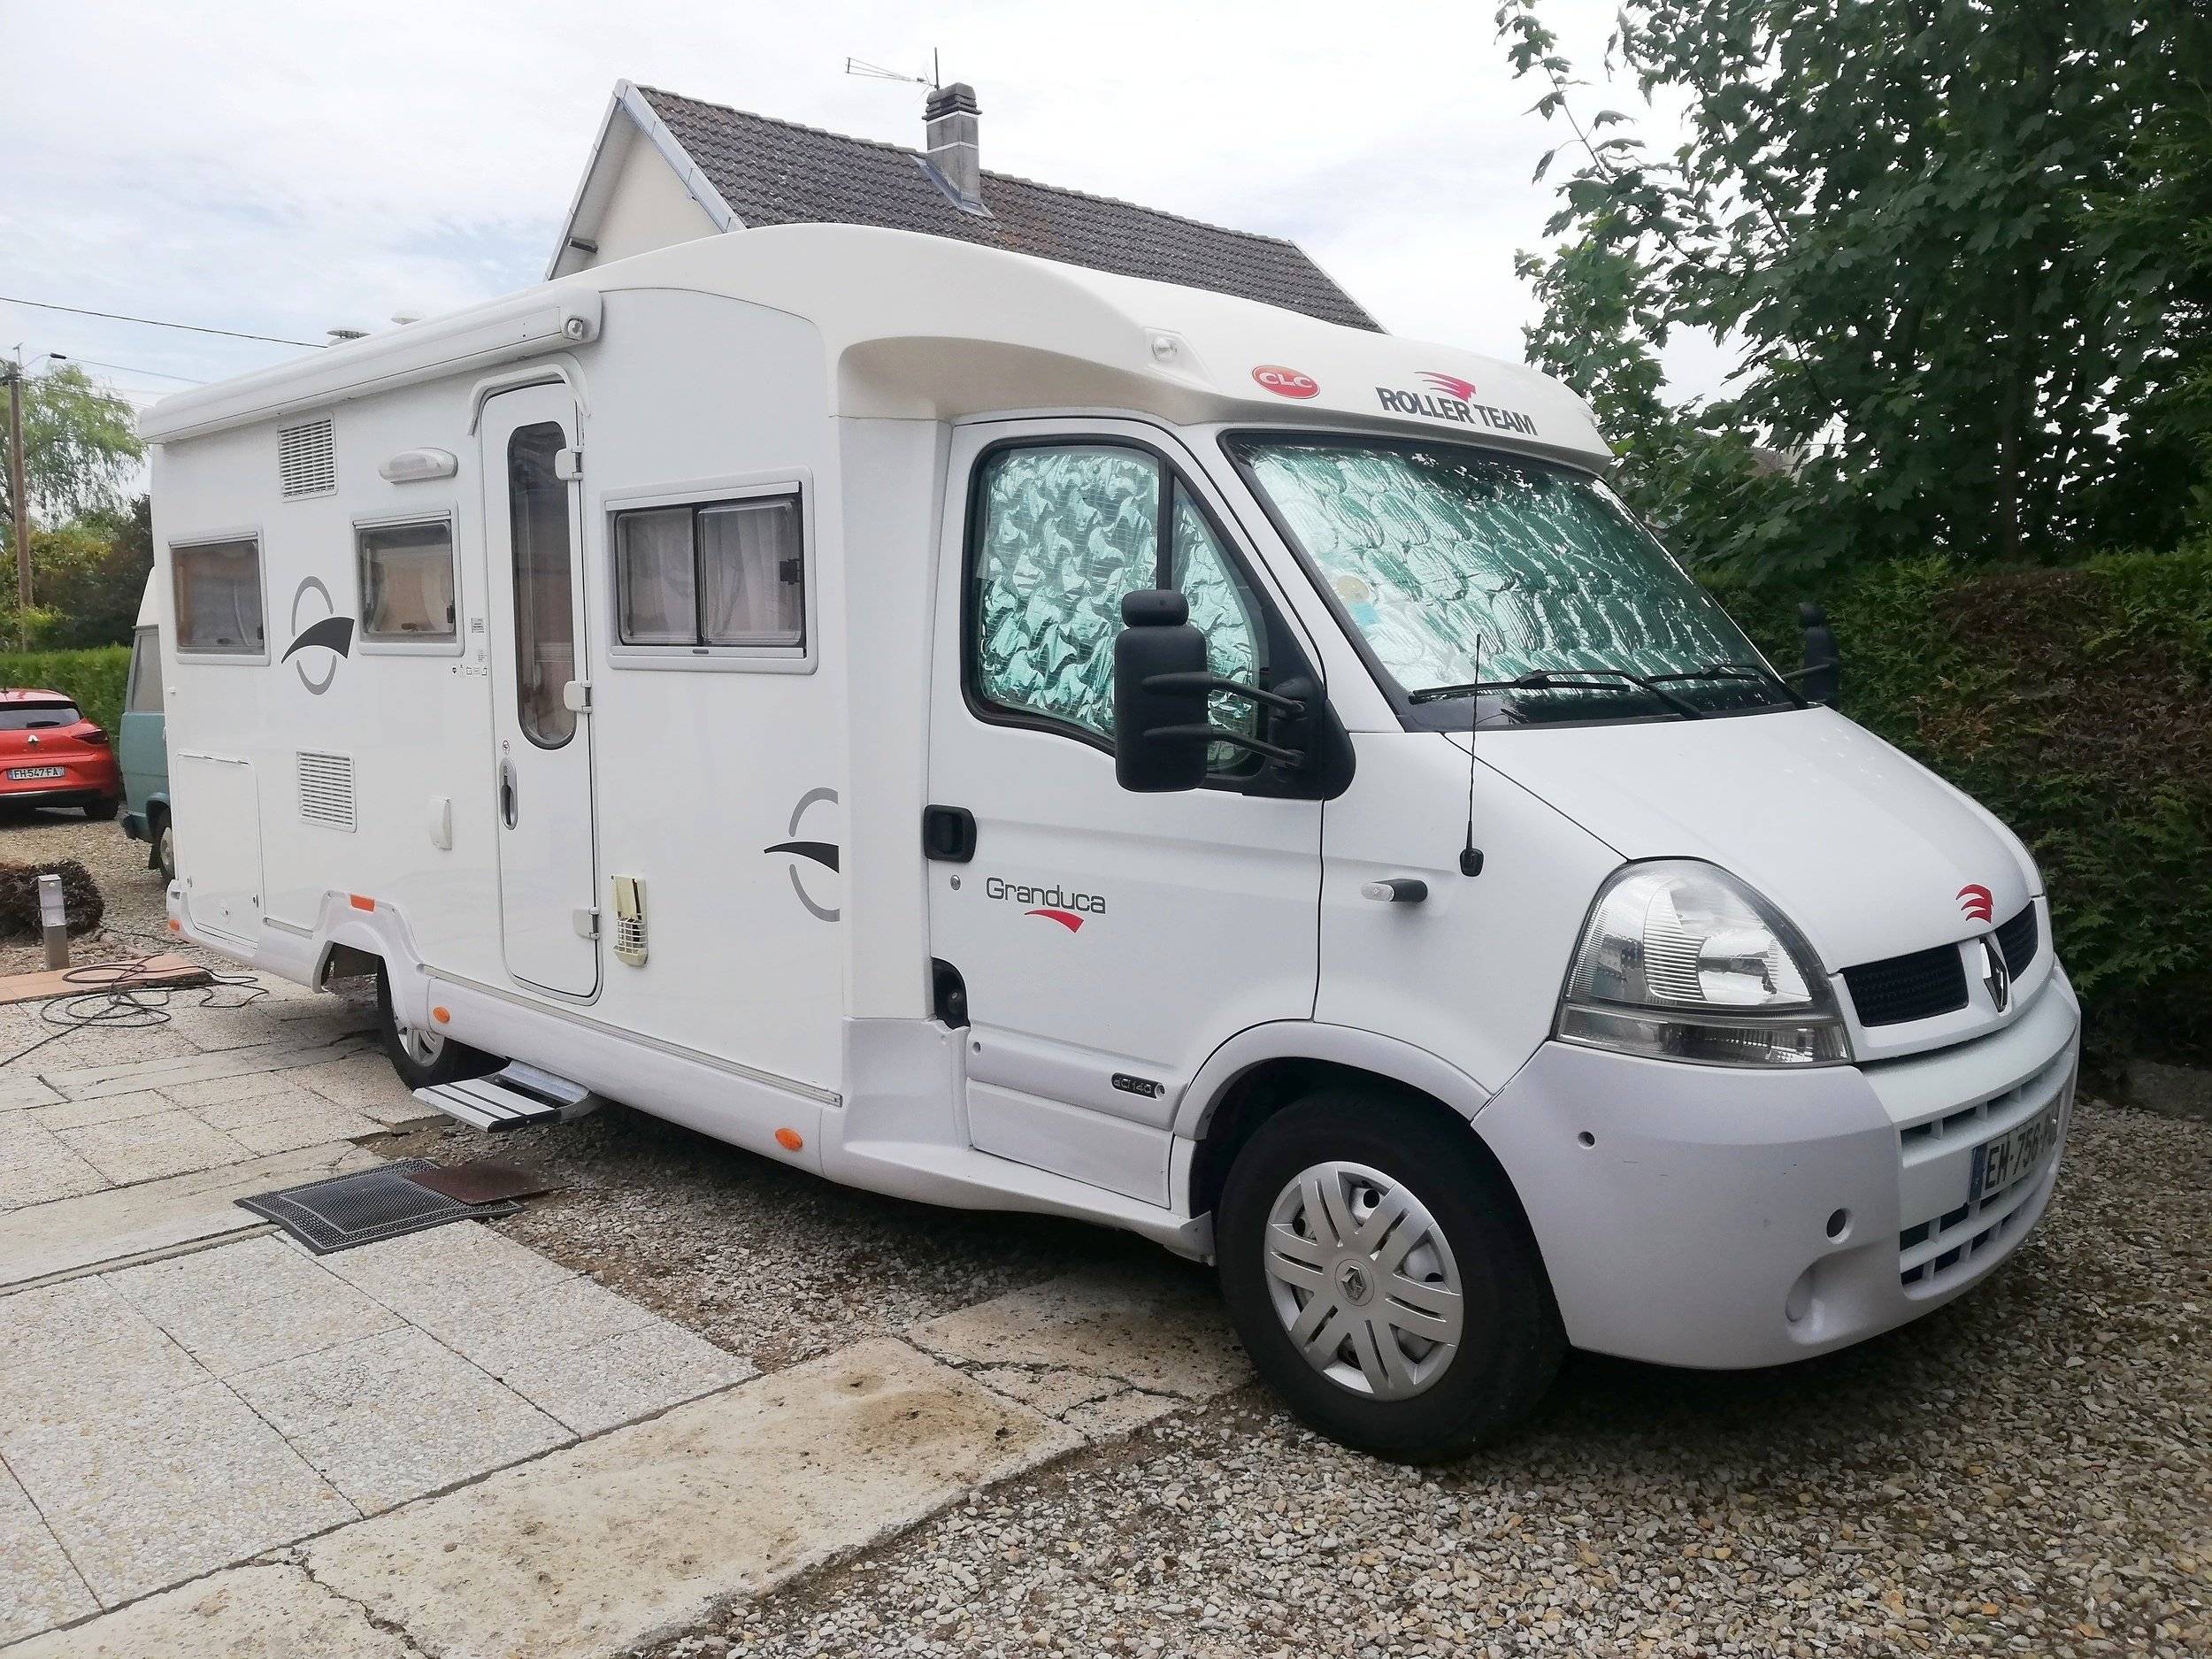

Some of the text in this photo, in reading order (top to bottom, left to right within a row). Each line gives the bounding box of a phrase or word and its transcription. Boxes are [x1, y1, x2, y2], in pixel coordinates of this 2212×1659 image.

[1259, 372, 1313, 388] CLC
[1376, 387, 1539, 436] ROLLER TEAM
[986, 877, 1106, 914] Granduca
